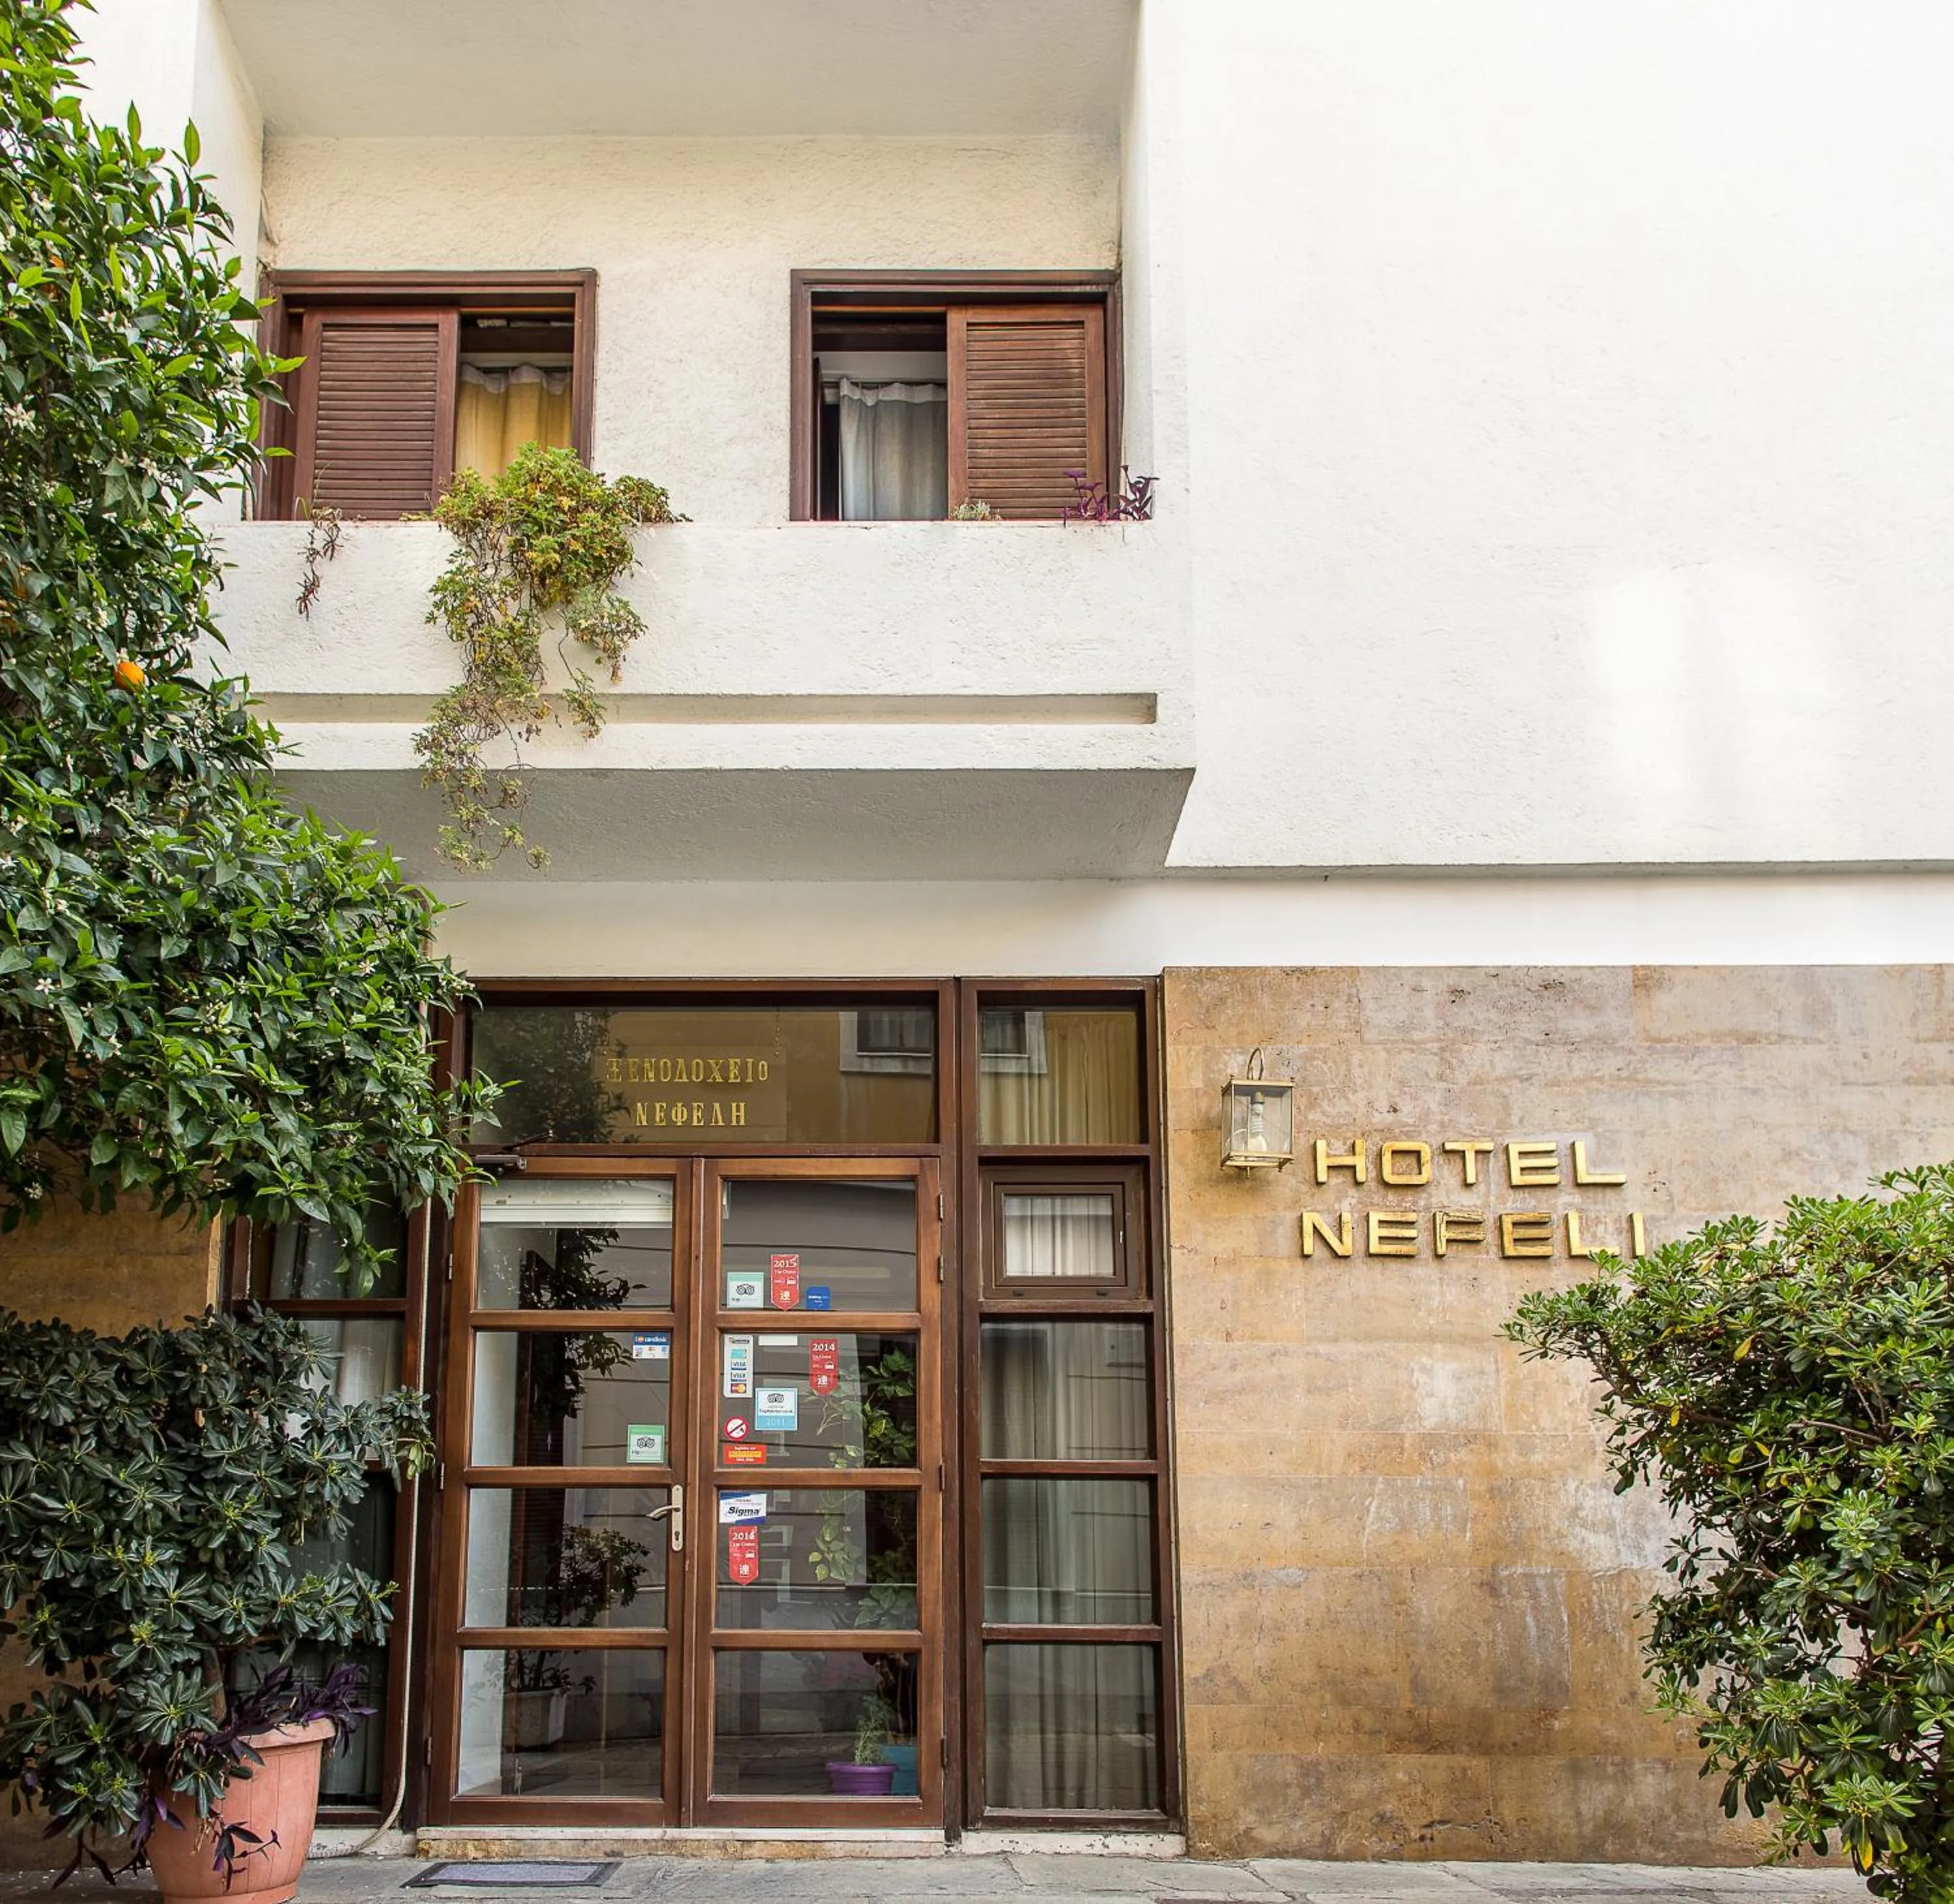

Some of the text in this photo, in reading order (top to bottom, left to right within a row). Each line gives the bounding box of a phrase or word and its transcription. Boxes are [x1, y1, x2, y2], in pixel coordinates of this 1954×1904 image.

[635, 1102, 746, 1126] ΝΕΦΕΛΗ
[1314, 1138, 1627, 1186] HOTEL
[1301, 1210, 1646, 1257] NEFELI
[728, 1506, 759, 1517] Sigma
